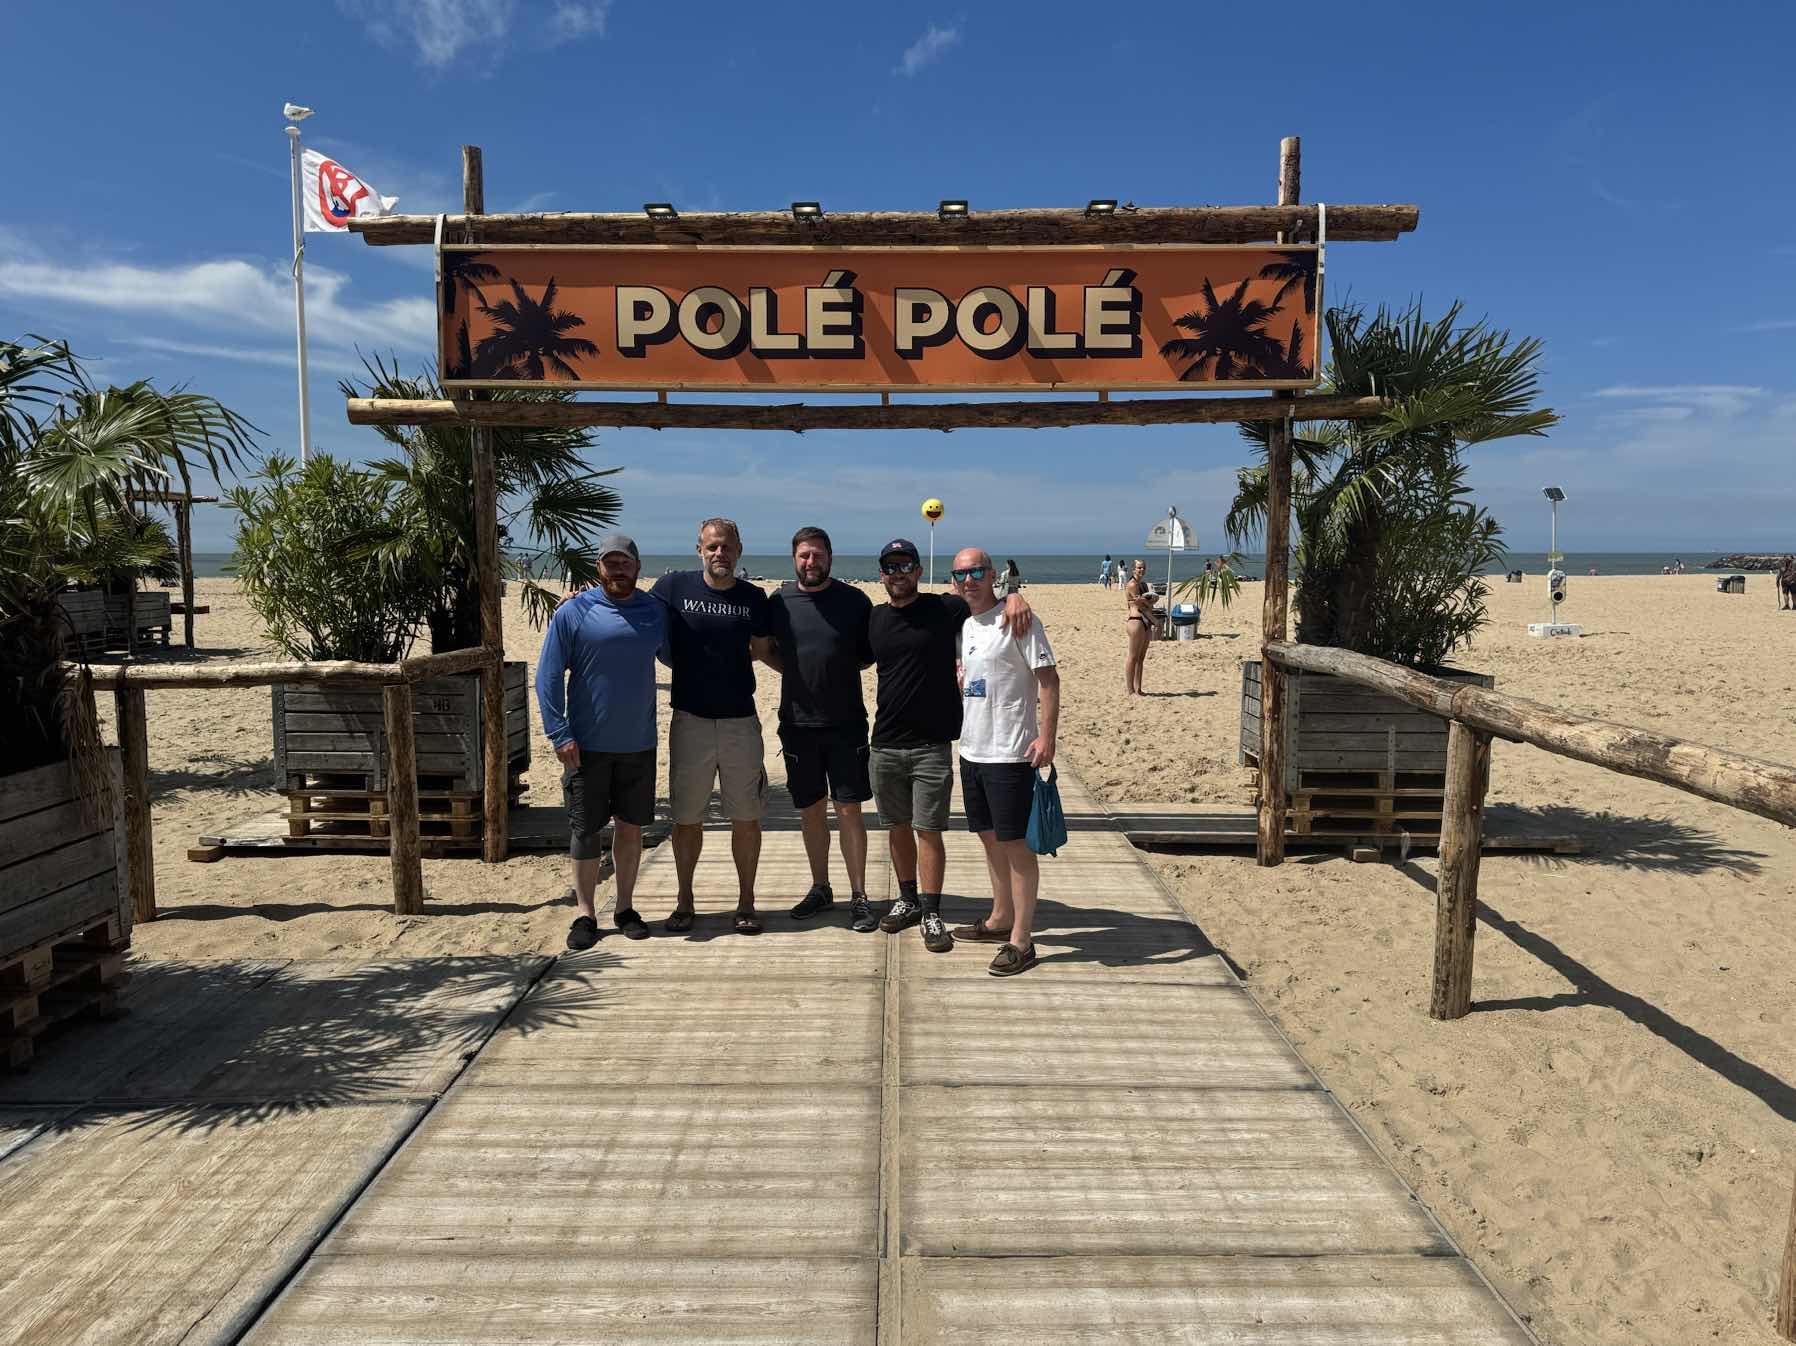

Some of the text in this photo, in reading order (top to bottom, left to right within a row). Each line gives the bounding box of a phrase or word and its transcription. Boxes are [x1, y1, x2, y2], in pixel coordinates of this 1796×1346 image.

[615, 270, 1141, 358] POLÉ POLÉ
[683, 599, 751, 617] WARRIOR
